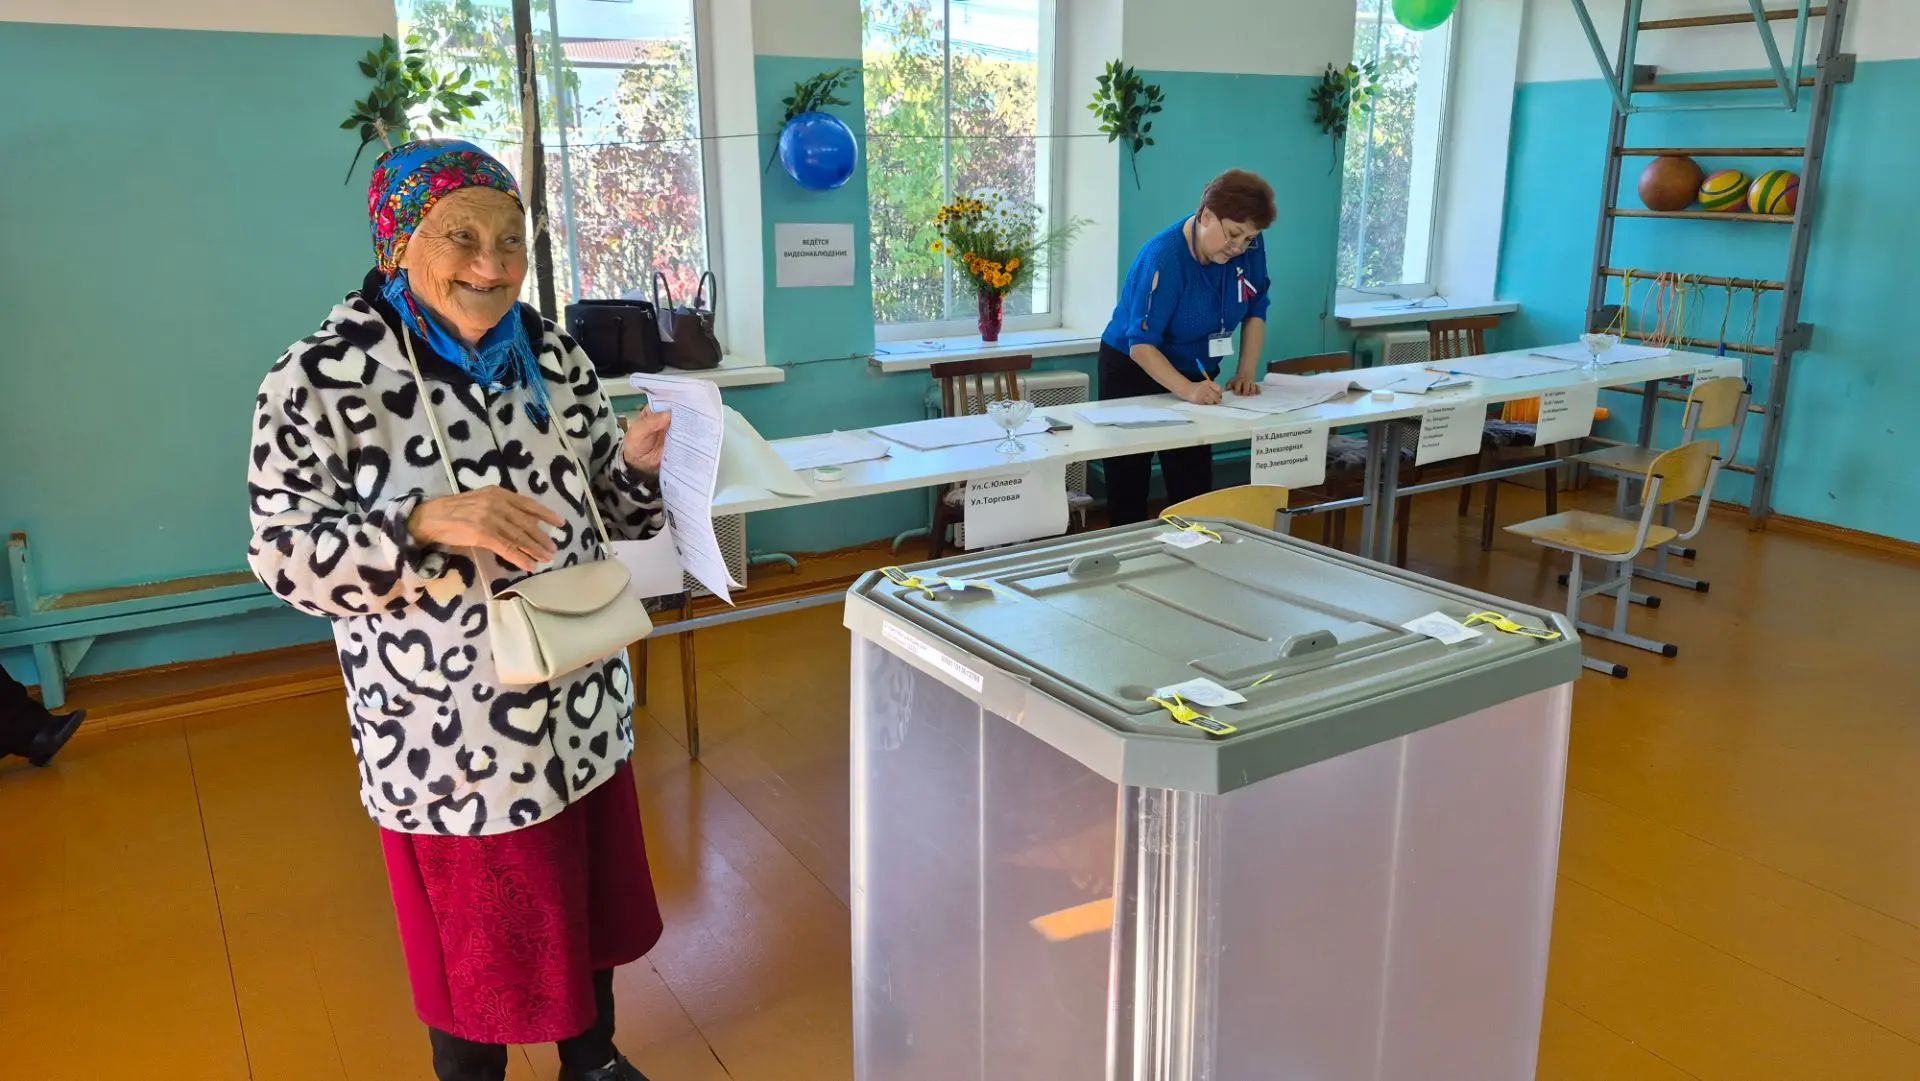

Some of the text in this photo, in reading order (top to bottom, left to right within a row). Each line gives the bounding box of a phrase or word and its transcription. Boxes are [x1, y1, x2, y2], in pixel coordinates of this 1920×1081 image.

[802, 237, 830, 246] ВЕДЁТСЯ
[784, 250, 848, 258] ВИДЕОНАБЛЮДЕНИЕ
[971, 478, 1023, 491] Ул.С.Юлаева
[970, 493, 1021, 506] Ул.Торговая
